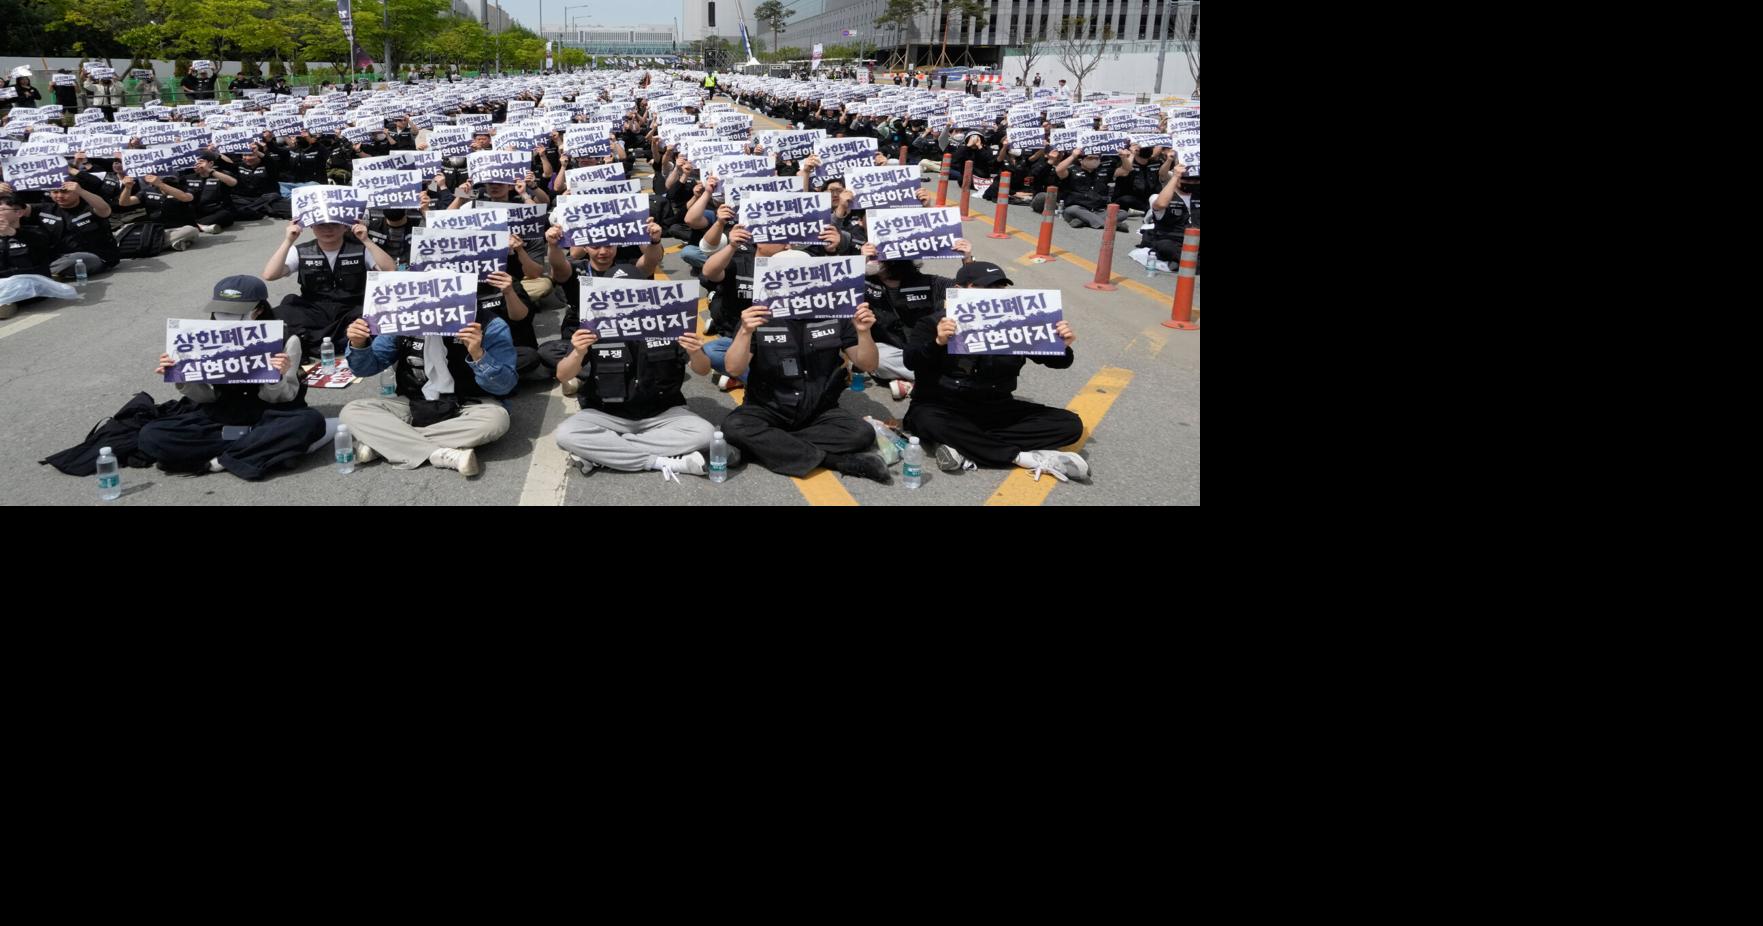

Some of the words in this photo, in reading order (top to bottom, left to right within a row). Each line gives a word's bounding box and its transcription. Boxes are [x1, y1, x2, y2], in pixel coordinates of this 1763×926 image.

[429, 133, 466, 147] 상한폐지
[566, 132, 604, 148] 상한폐지
[776, 130, 820, 148] 상한폐지
[124, 151, 164, 166] 상한폐지
[691, 144, 734, 158] 상한폐지
[818, 140, 870, 159] 상한폐지
[8, 157, 59, 175] 상한폐지
[127, 161, 172, 179] 실현하자
[470, 153, 514, 172] 상한폐지
[717, 157, 768, 176] 상한폐지
[13, 172, 66, 191] 실현하자
[357, 172, 414, 190] 상한폐지
[850, 168, 911, 190] 상한폐지
[296, 189, 358, 209] 상한폐지
[745, 195, 820, 219] 상한폐지
[858, 187, 918, 209] 실현하자
[301, 207, 364, 227] 실현하자
[563, 196, 637, 222] 상한폐지
[571, 220, 648, 246] 실현하자
[751, 220, 828, 243] 실현하자
[874, 210, 949, 237] 상한폐지
[418, 234, 497, 256] 상한폐지
[882, 234, 957, 260] 실현하자
[762, 259, 852, 289] 상한폐지
[373, 276, 462, 304] 상한폐지
[588, 283, 684, 310] 상한폐지
[907, 294, 927, 302] SELU
[482, 300, 501, 309] SELU
[769, 288, 864, 317] 실현하자
[955, 293, 1047, 323] 상한폐지
[378, 305, 475, 333] 실현하자
[596, 311, 697, 337] 실현하자
[174, 324, 267, 352] 상한폐지
[646, 338, 671, 349] SELU
[764, 335, 787, 343] 투쟁
[811, 330, 835, 339] SELU
[965, 323, 1058, 353] 실현하자
[598, 349, 622, 359] 투쟁
[182, 352, 275, 382] 실현하자
